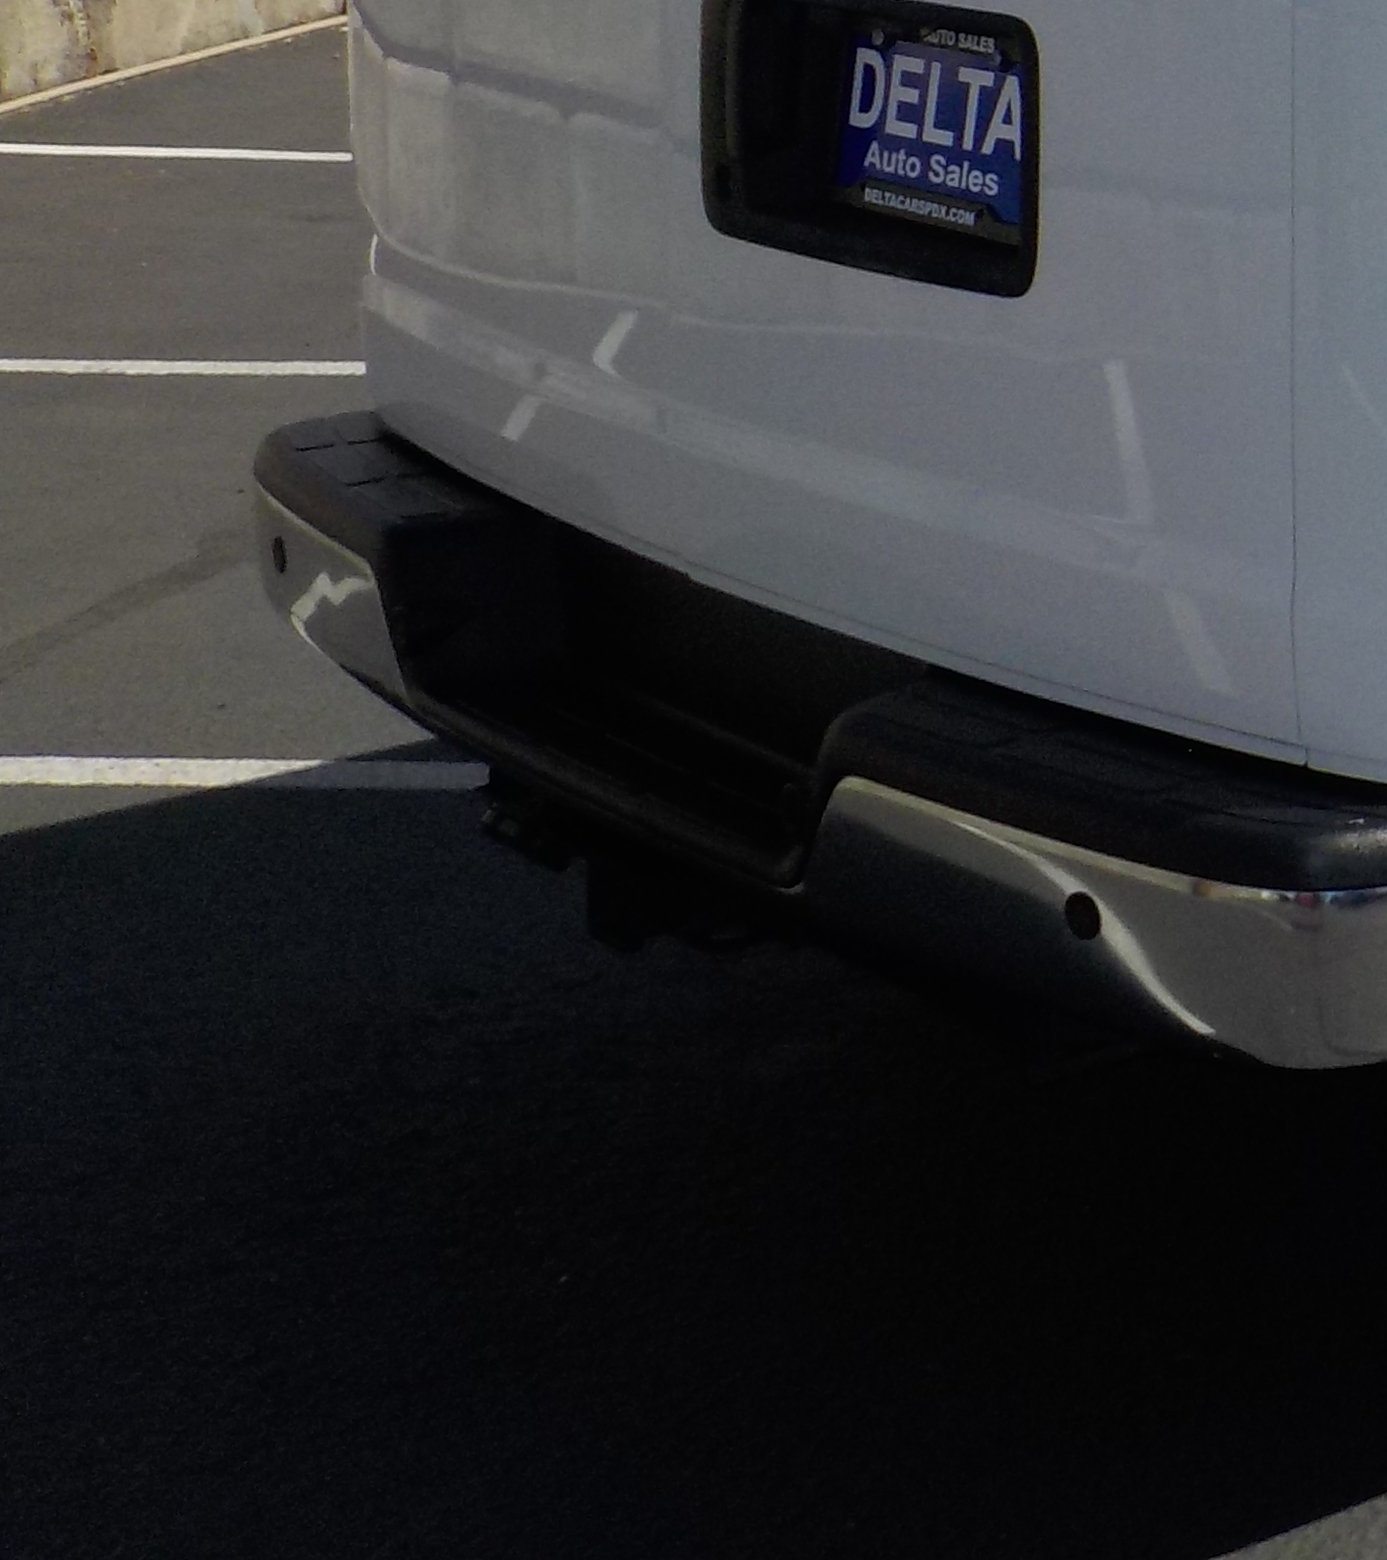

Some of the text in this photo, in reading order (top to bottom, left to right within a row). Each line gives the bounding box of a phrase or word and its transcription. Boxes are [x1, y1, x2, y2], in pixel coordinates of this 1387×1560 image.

[957, 32, 996, 54] SALES
[848, 47, 1021, 162] DELTA
[864, 140, 999, 196] Auto Sales
